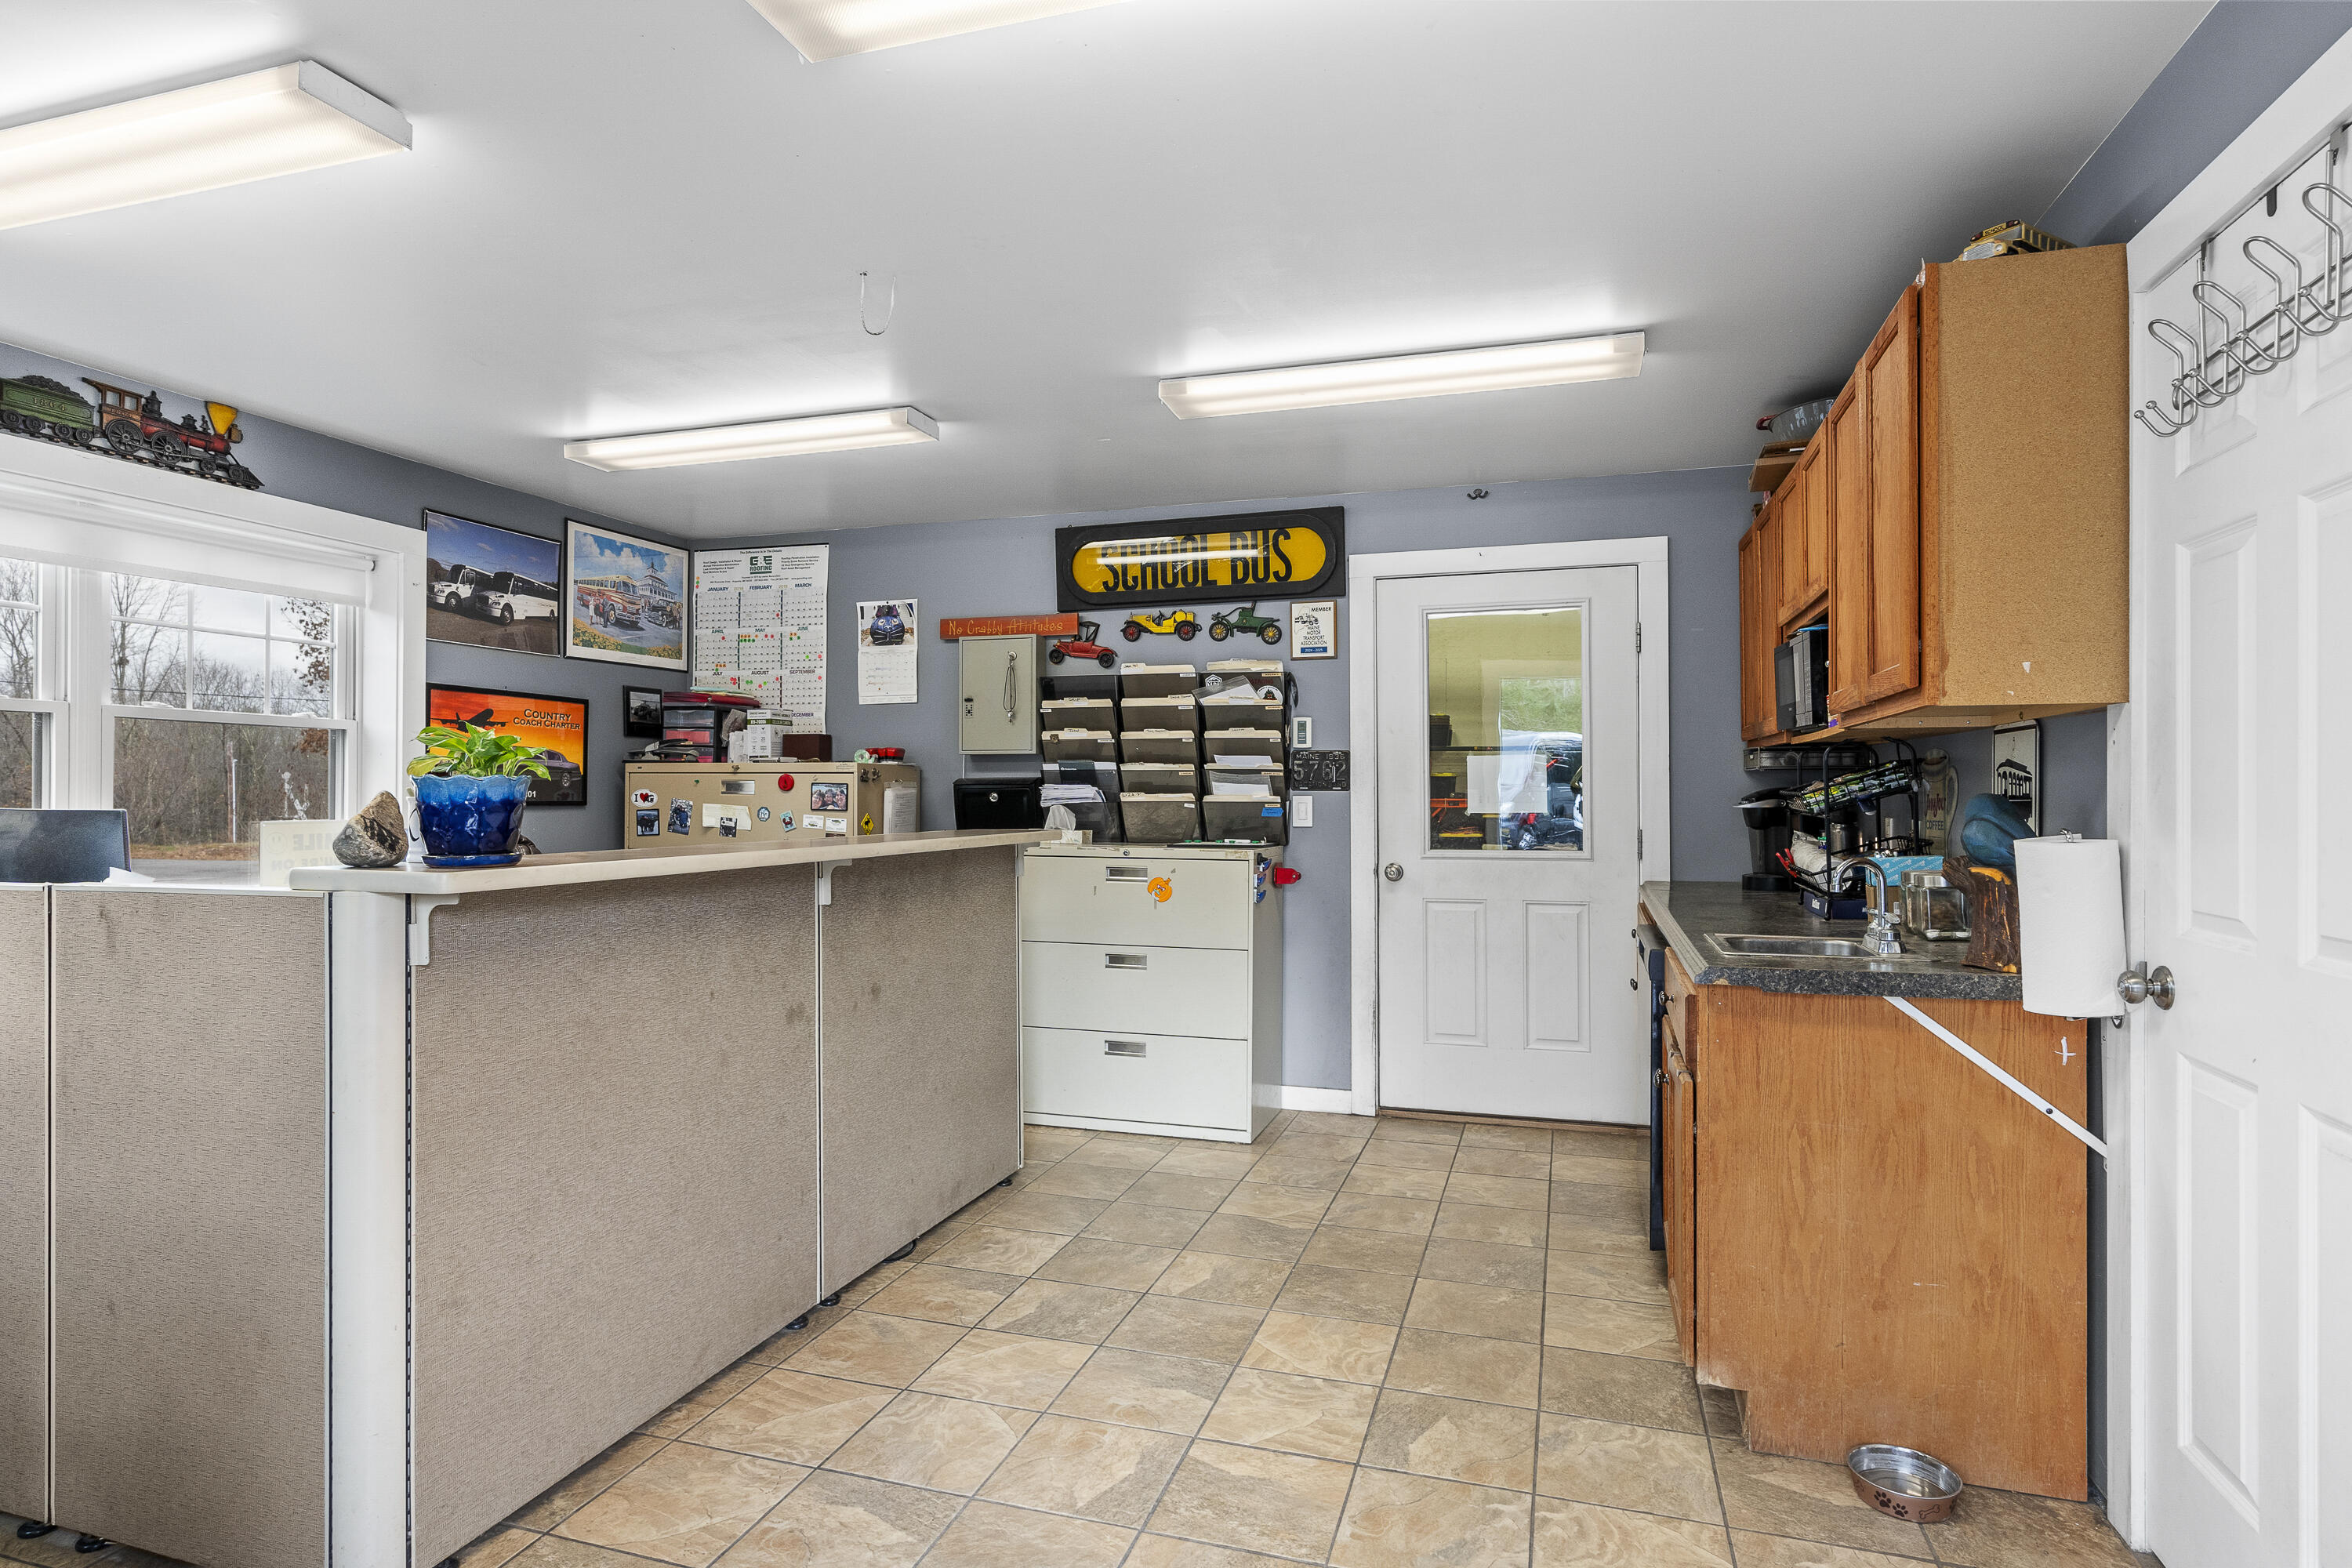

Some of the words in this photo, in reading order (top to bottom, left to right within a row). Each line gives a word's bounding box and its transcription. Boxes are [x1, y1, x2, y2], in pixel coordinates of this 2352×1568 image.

[1101, 533, 1218, 592] SCHOOL
[1229, 528, 1293, 586] BUS
[949, 620, 962, 635] No
[967, 619, 1003, 637] Crabby
[1007, 617, 1063, 634] Attitudes
[524, 708, 572, 721] COUNTRY
[513, 717, 542, 727] COACH
[544, 720, 581, 730] CHARTER
[1926, 820, 1944, 830] COFFEE
